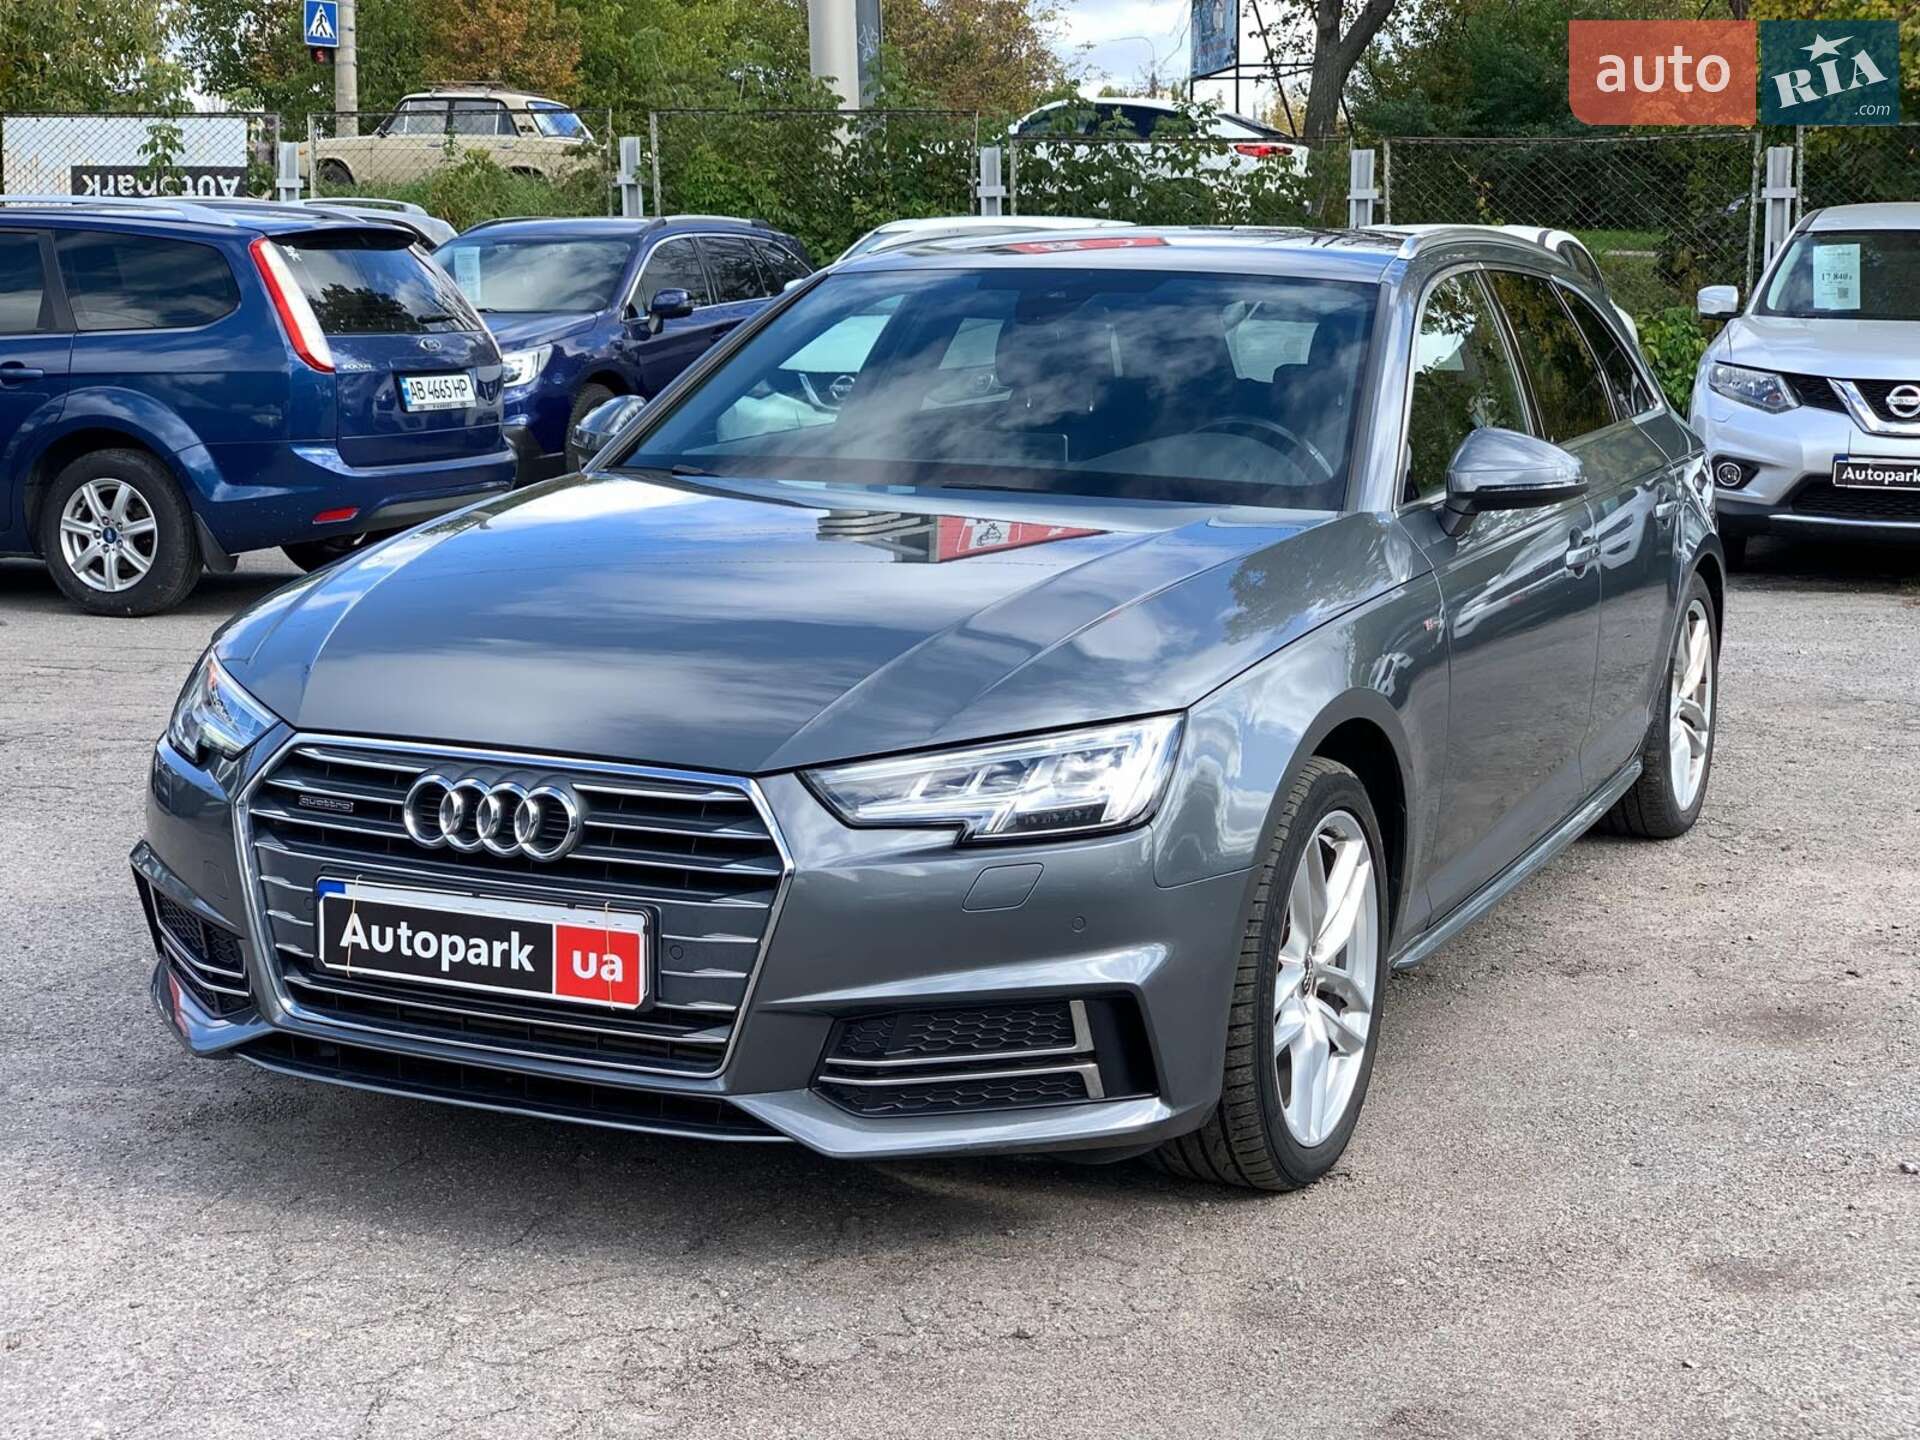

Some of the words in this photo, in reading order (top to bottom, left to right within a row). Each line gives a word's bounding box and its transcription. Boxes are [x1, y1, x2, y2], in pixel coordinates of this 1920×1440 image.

[410, 381, 426, 400] AB
[427, 380, 452, 400] 4665
[454, 379, 468, 399] HP
[1842, 466, 1920, 485] Autopark
[339, 912, 536, 972] Autopark
[571, 949, 624, 983] ua
